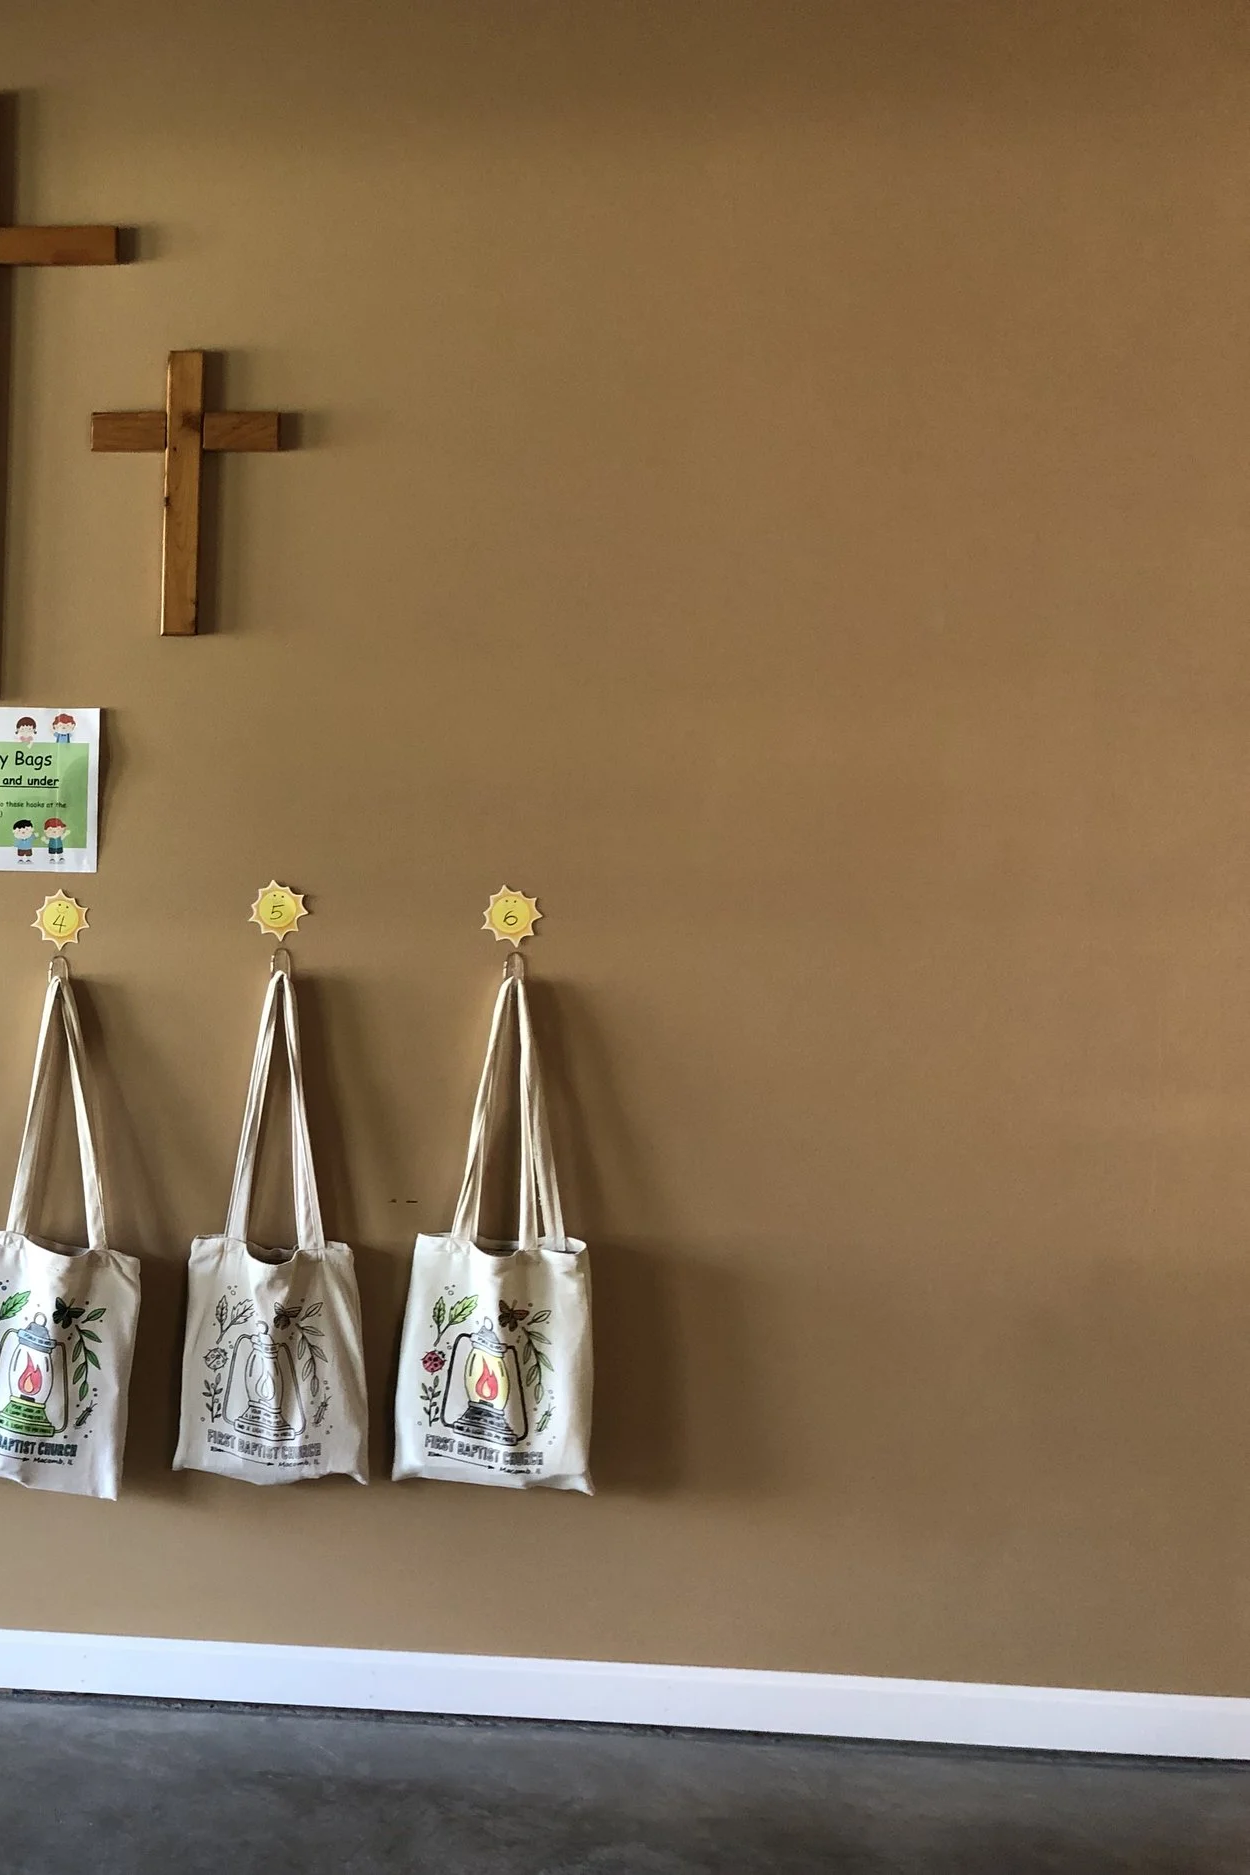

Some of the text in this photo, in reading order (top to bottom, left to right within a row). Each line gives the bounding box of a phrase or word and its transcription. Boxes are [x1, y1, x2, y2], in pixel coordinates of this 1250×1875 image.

[15, 751, 52, 770] Bags
[3, 776, 22, 785] and
[27, 776, 59, 786] under
[269, 905, 285, 920] 5
[503, 910, 518, 926] 6
[52, 914, 66, 933] 4
[38, 1442, 77, 1457] CHURCH
[207, 1429, 235, 1449] FIRST
[238, 1438, 279, 1459] BAPTIST
[281, 1443, 322, 1459] CHURCH
[425, 1434, 543, 1465] FIRST BAPTIST CHURCH
